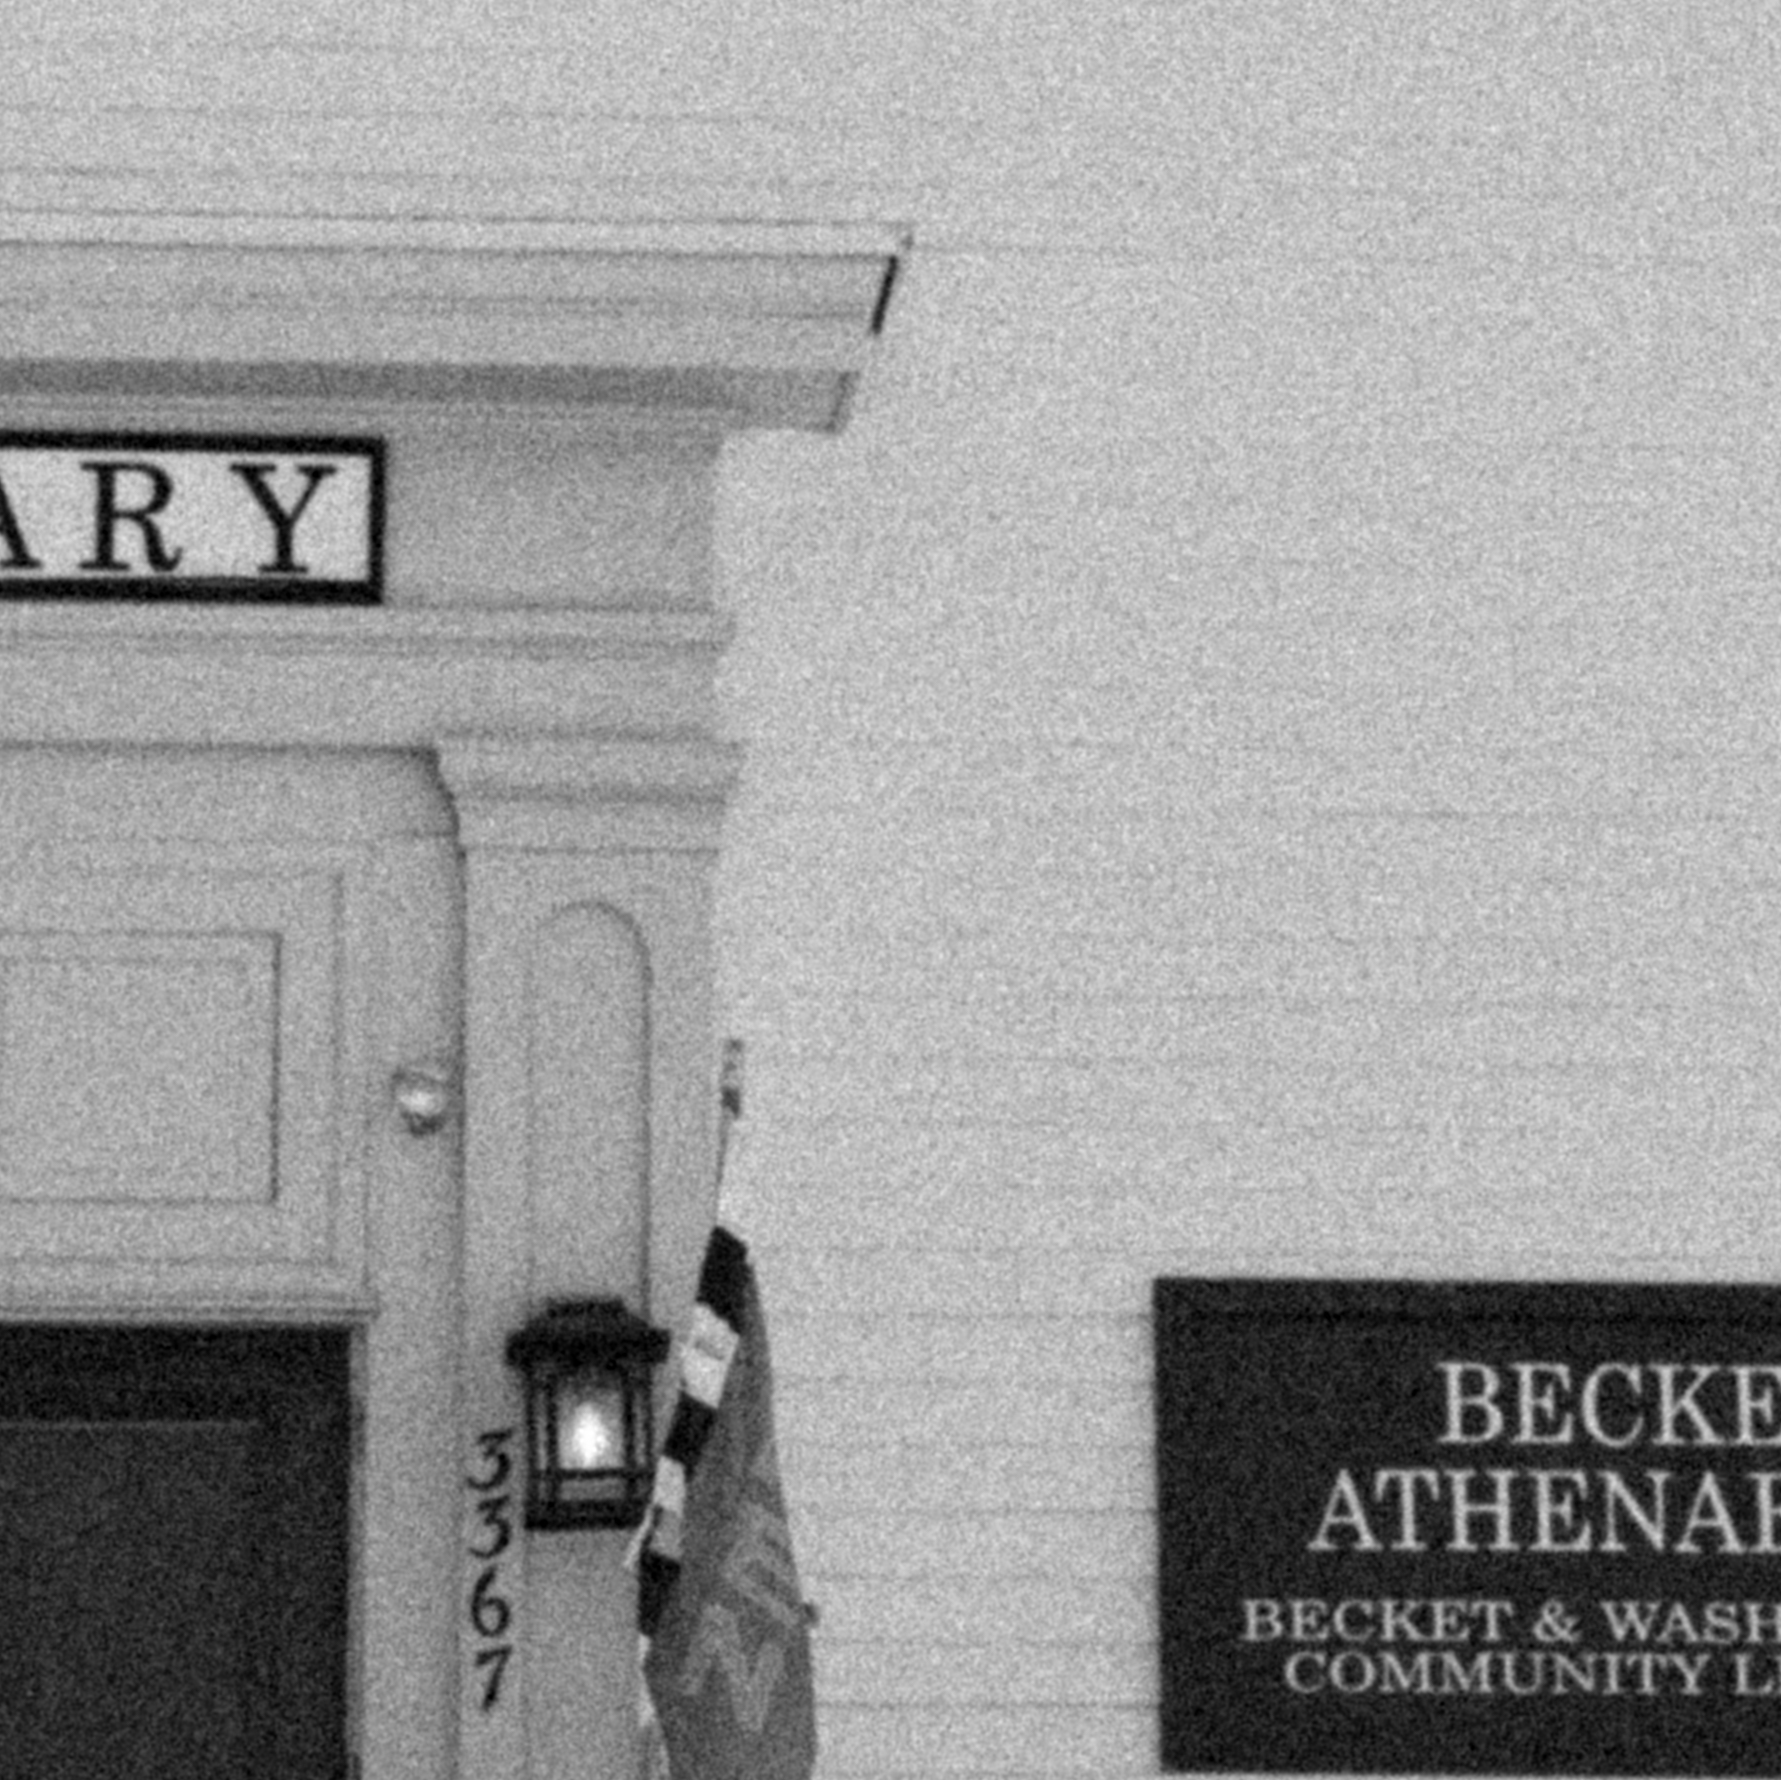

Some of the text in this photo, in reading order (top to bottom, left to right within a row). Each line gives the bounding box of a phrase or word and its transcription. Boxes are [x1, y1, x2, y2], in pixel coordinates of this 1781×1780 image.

[466, 1427, 513, 1711] 3367
[1244, 1599, 1512, 1641] BECKET
[1533, 1601, 1578, 1643] &
[1285, 1651, 1708, 1694] COMMUNITY
